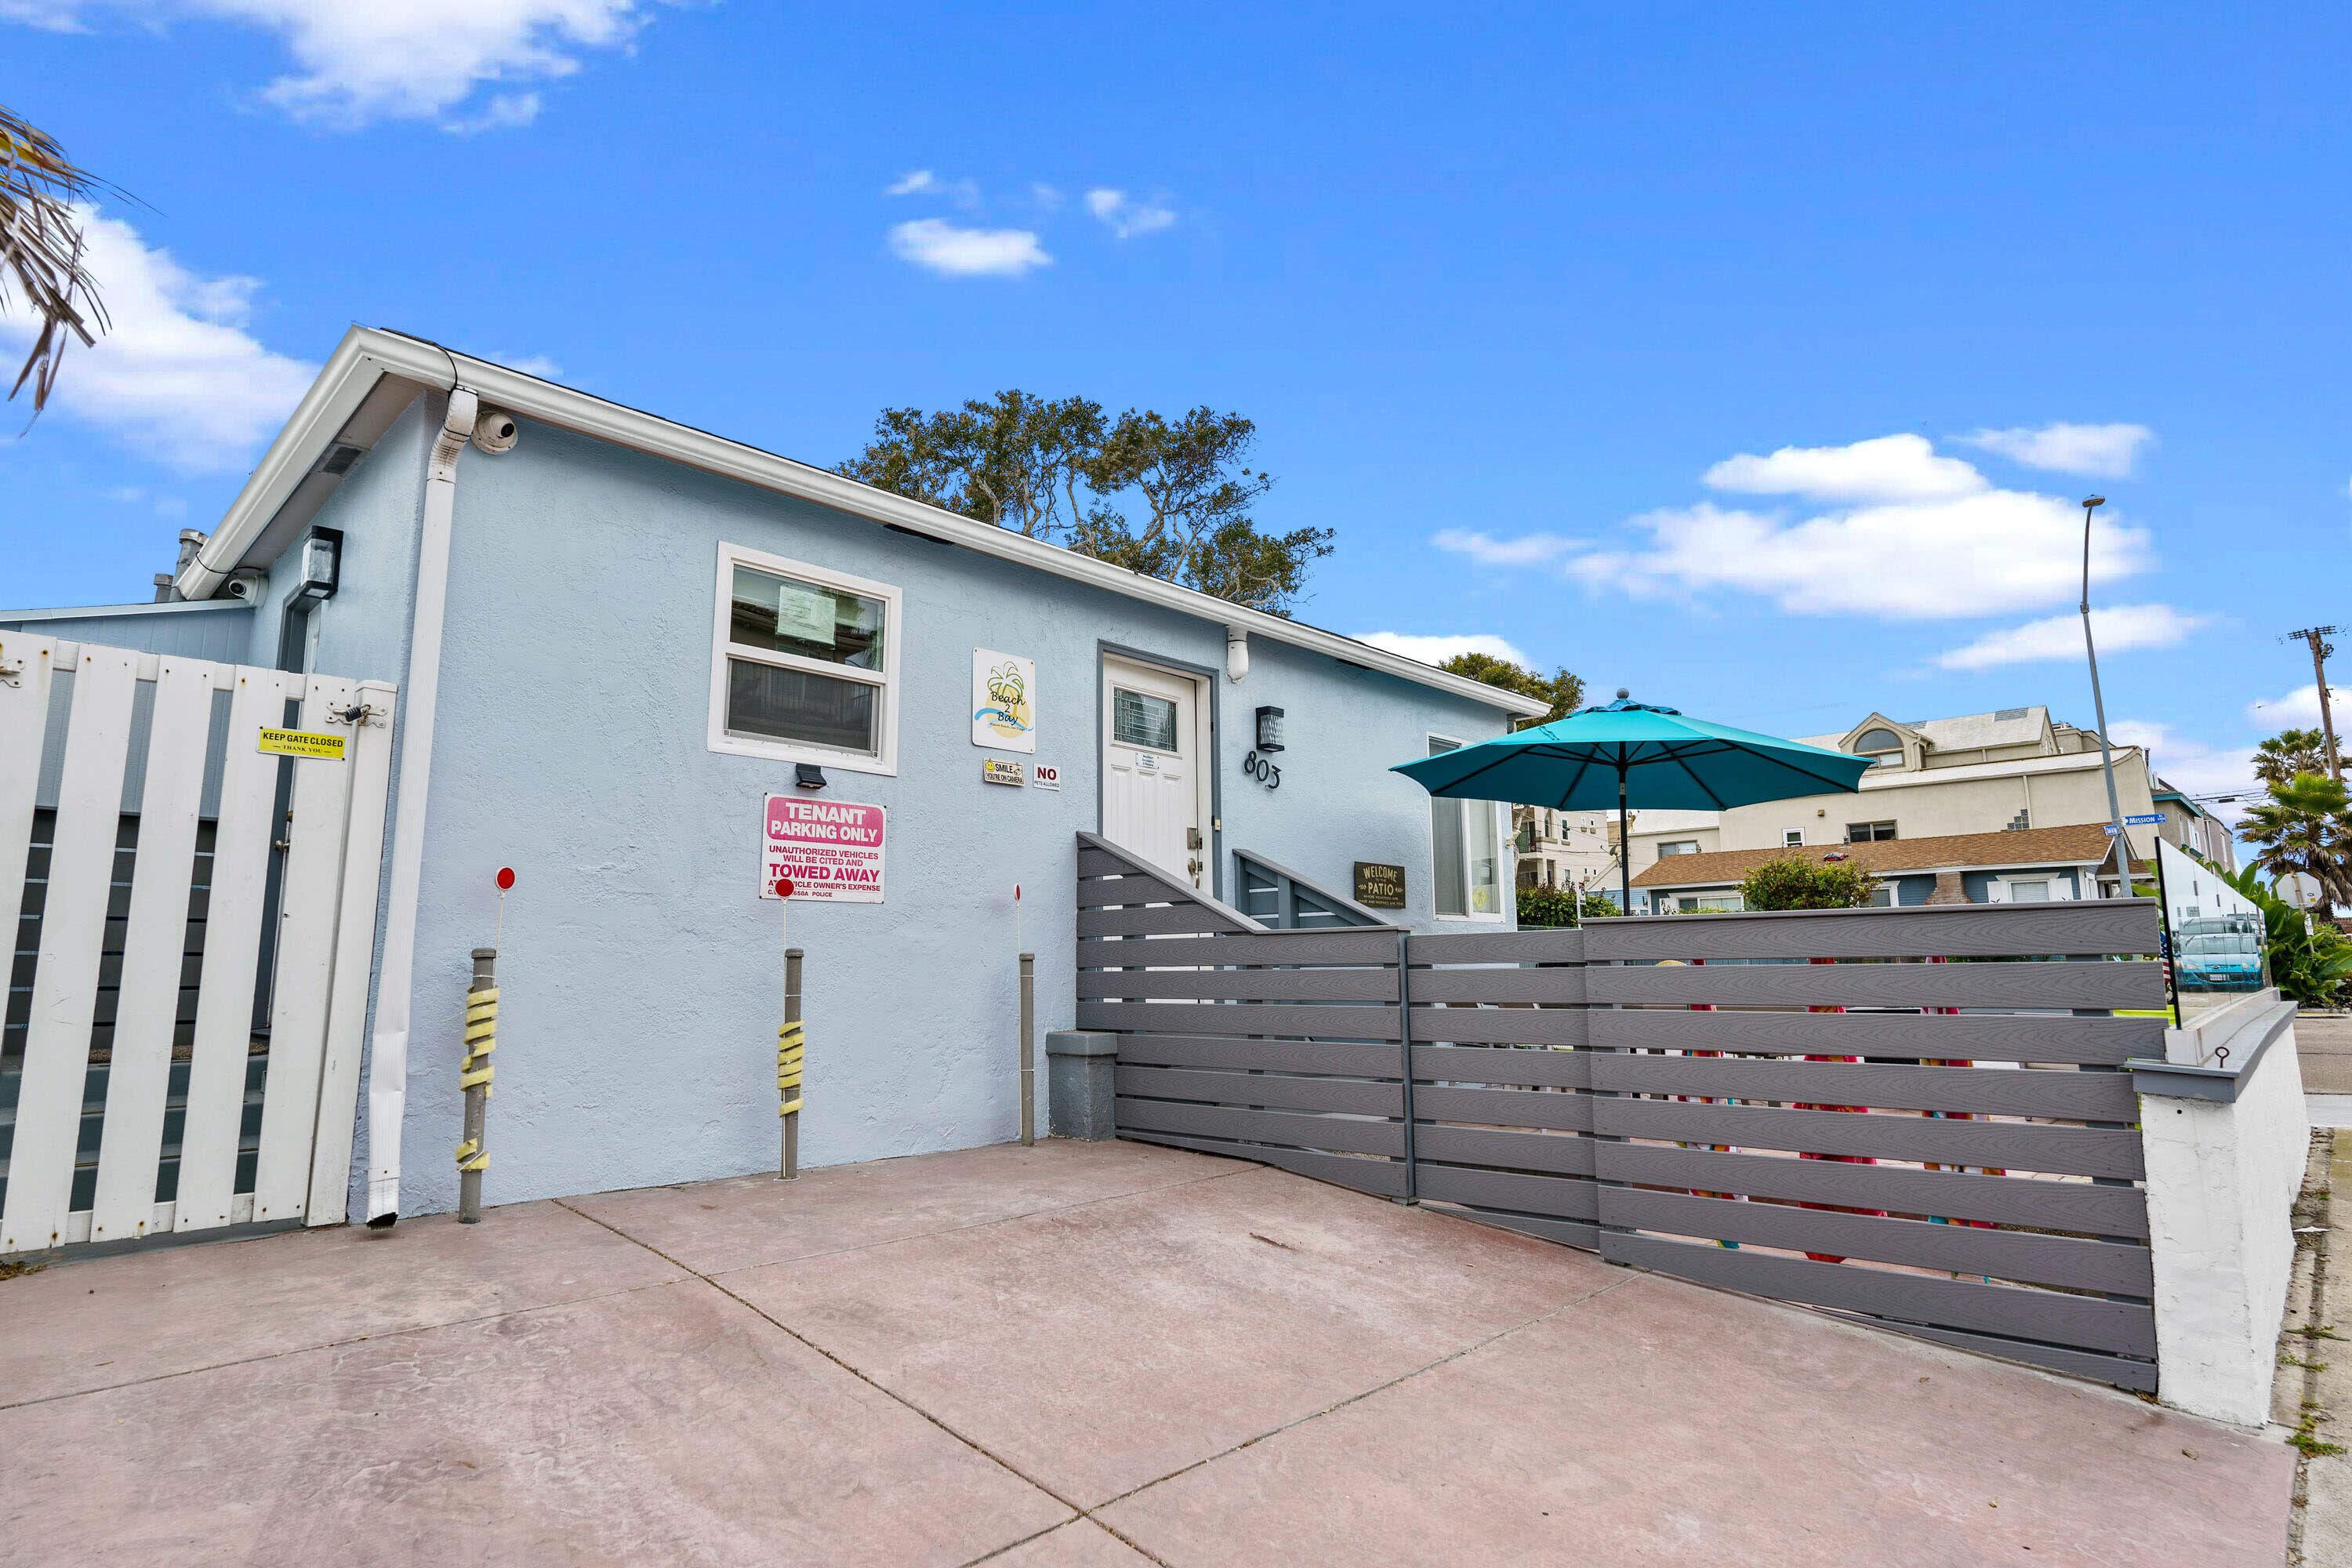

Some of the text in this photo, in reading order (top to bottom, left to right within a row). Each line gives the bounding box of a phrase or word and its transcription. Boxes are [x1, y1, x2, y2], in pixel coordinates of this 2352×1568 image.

[991, 691, 1025, 706] Beach
[1004, 704, 1010, 713] 2
[997, 712, 1018, 725] Bay
[263, 731, 343, 747] KEEP GATE CLOSED
[995, 764, 1013, 774] SMILE
[1037, 767, 1057, 781] NO
[1244, 750, 1281, 789] 803
[786, 802, 866, 825] TENANT
[771, 820, 877, 843] PARKING ONLY
[769, 845, 879, 860] UNAUTHORIZED VEHICLES
[783, 855, 804, 863] WILL
[819, 857, 844, 866] CITED
[769, 863, 880, 883] TOWED AWAY
[1363, 866, 1398, 883] WELCOME
[1368, 882, 1394, 895] PATIO
